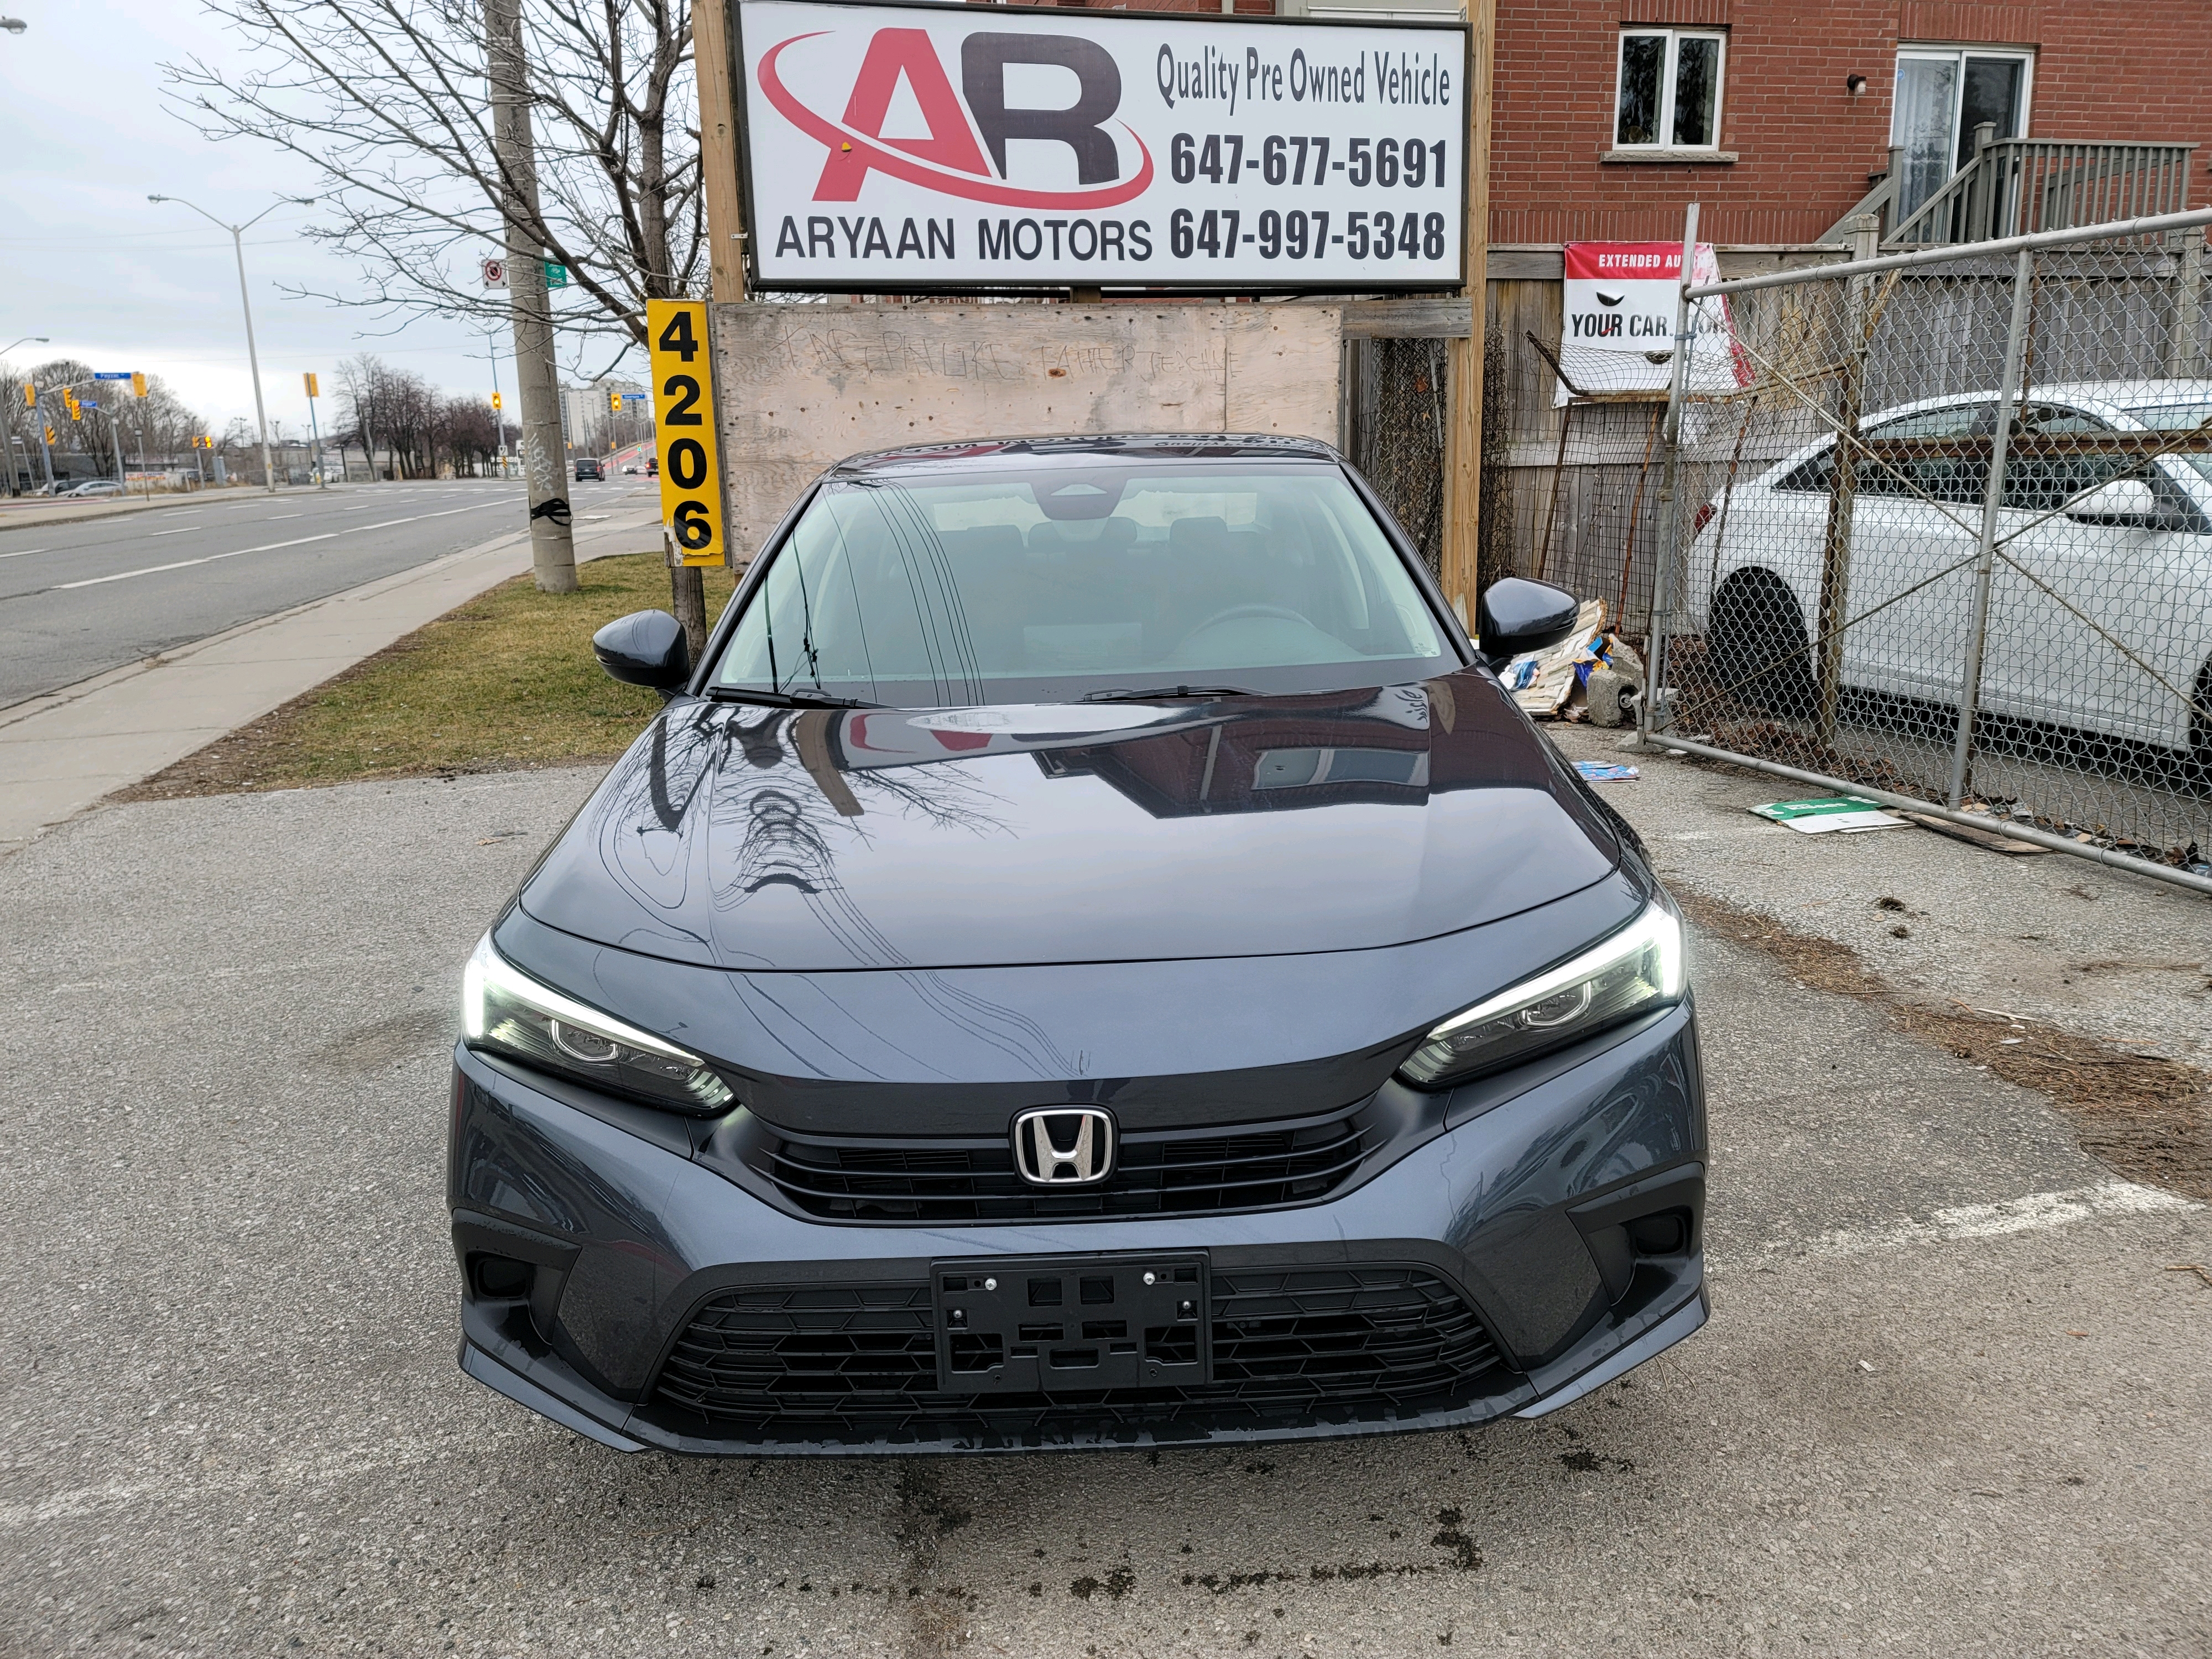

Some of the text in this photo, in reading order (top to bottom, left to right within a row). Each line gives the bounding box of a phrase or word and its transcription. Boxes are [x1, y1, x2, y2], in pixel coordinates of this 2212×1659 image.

[1157, 43, 1450, 116] Quality Pre Owned Vehicle
[812, 27, 1122, 202] AR
[1171, 132, 1446, 188] 647-677-5691
[775, 215, 1152, 262] ARYAAN MOTORS
[1170, 208, 1445, 260] 647-997-5348
[1599, 254, 1661, 268] EXTENDED
[1571, 313, 1623, 337] YOUR
[659, 311, 713, 550] 4206
